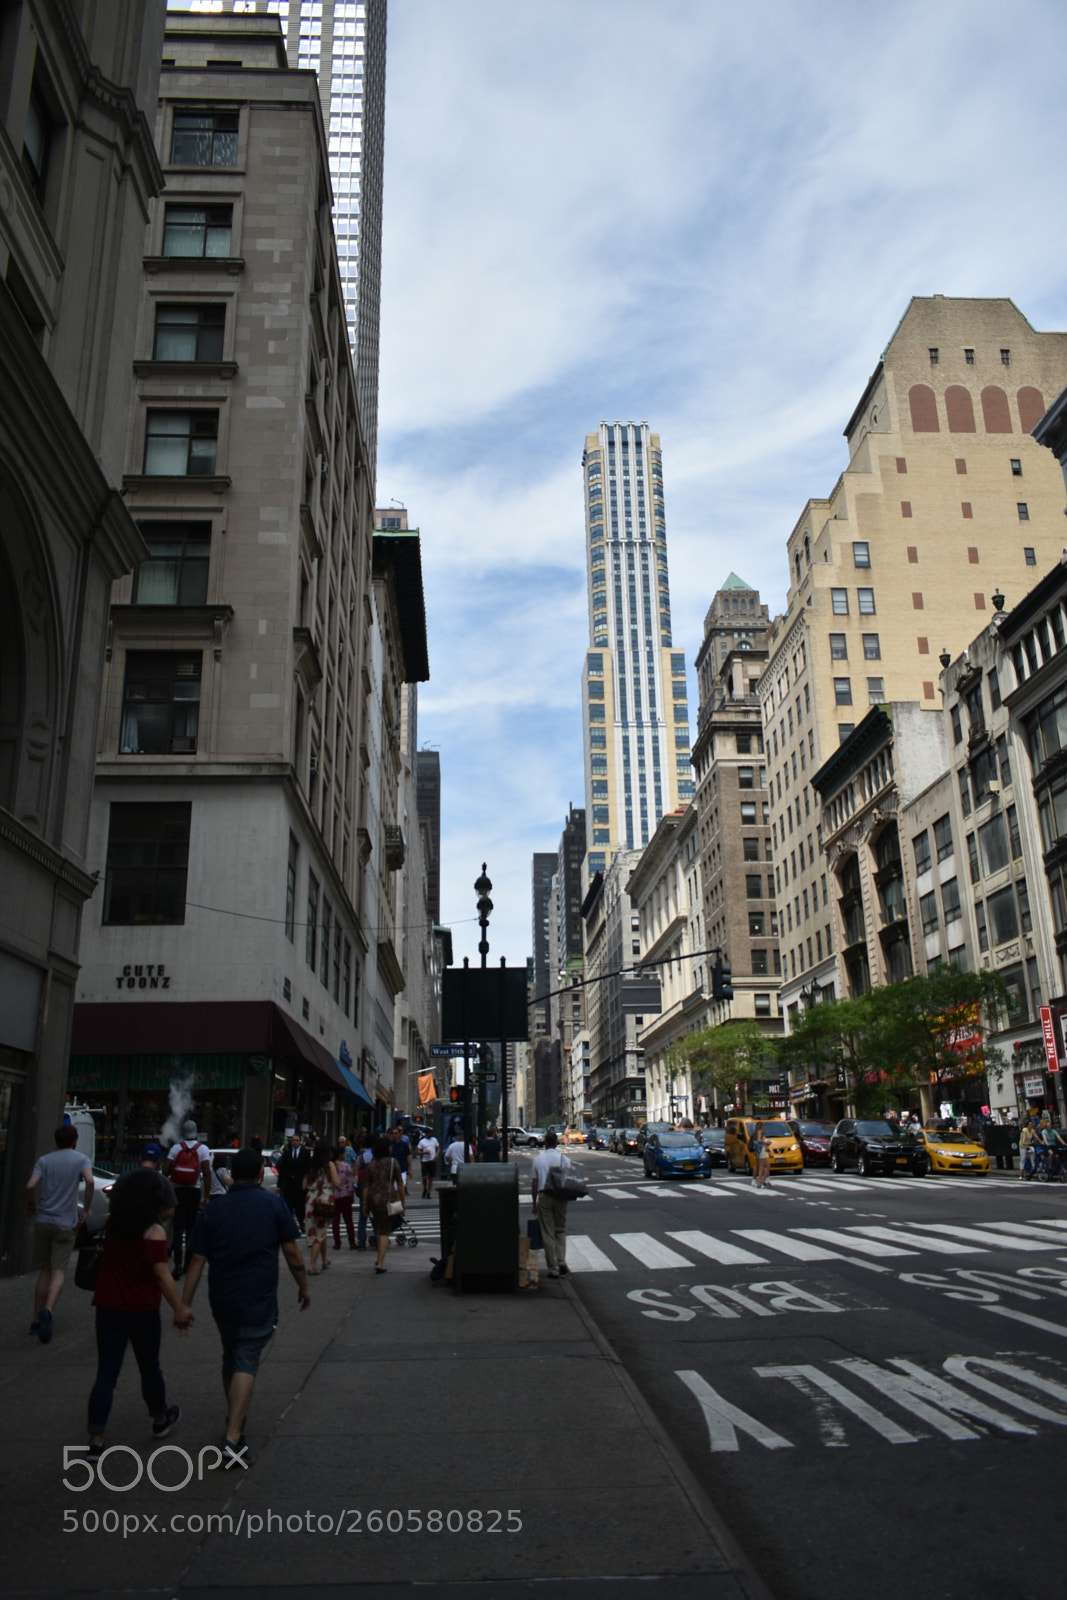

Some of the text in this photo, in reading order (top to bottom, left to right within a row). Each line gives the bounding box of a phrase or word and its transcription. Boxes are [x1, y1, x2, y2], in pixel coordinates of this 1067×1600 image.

[117, 977, 169, 988] TOONZ
[123, 965, 165, 977] CUTE
[1043, 1019, 1055, 1060] THE MILL
[627, 1281, 845, 1321] BUS
[674, 1356, 1067, 1452] ONLY
